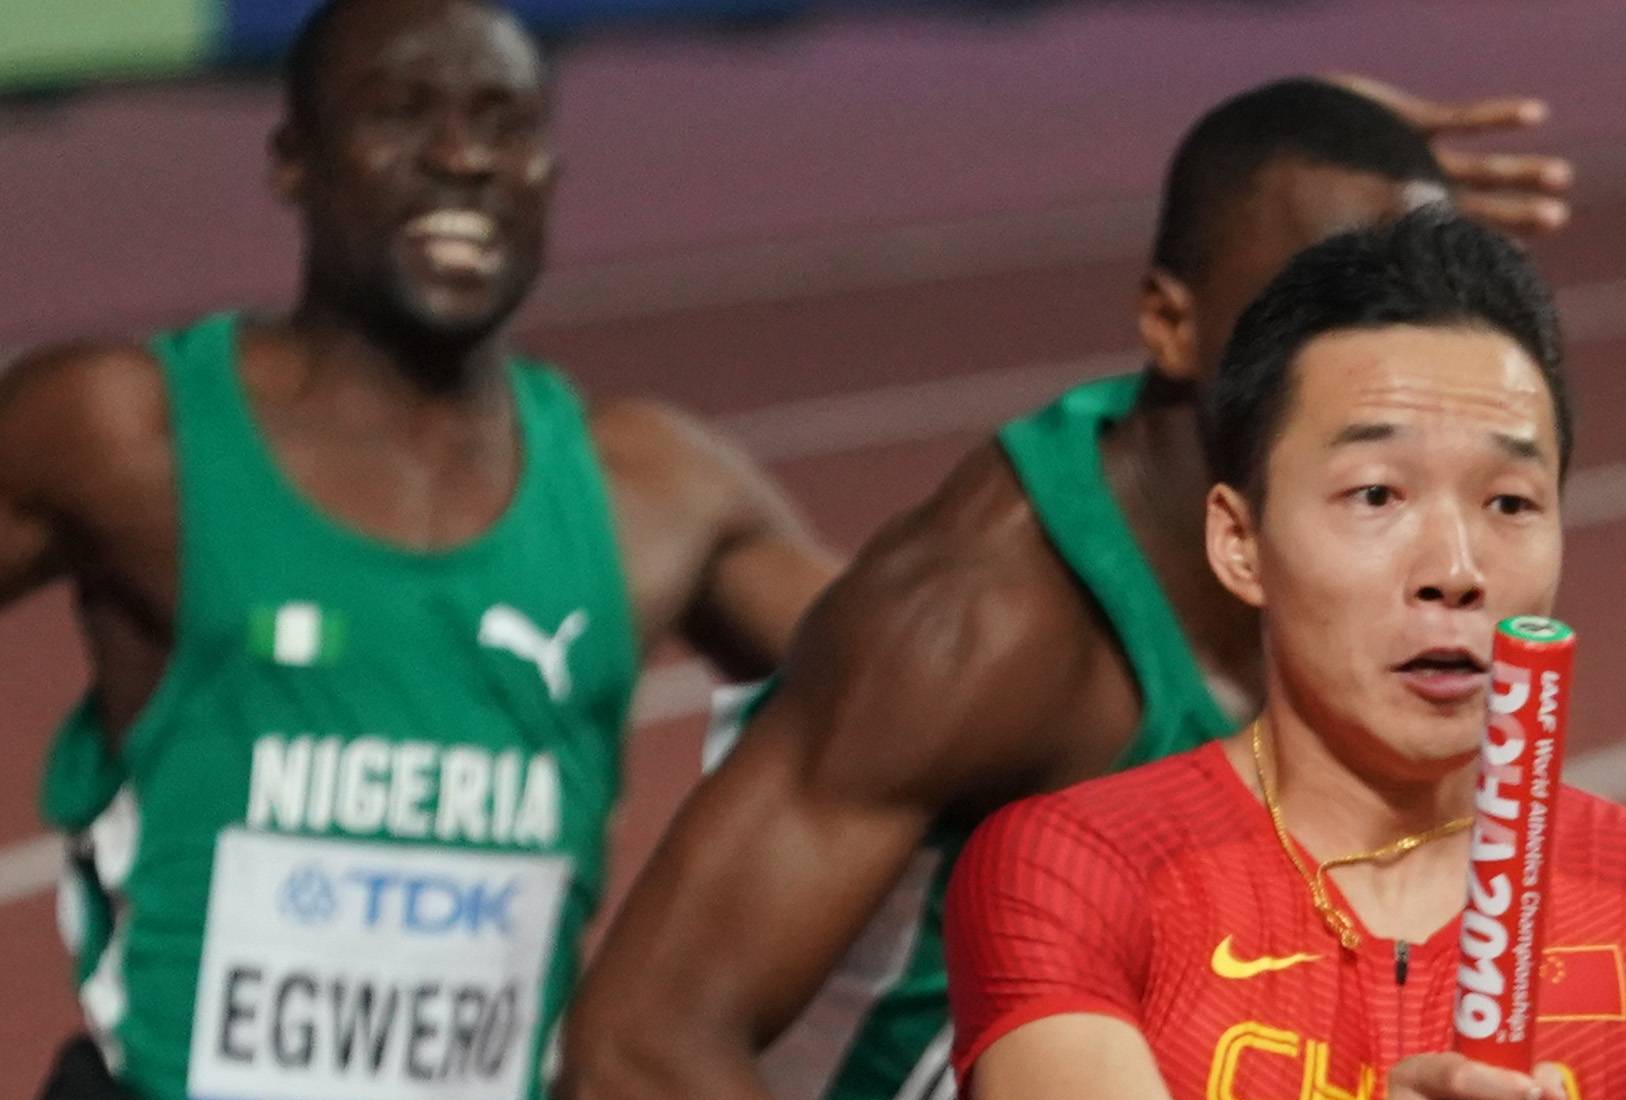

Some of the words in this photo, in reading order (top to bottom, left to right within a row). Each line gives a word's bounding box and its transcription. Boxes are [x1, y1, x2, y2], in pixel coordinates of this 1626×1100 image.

[1538, 671, 1560, 733] IAAF
[249, 735, 559, 844] NIGERIA
[1471, 662, 1531, 862] DOHA
[1532, 739, 1554, 798] World
[1522, 802, 1548, 887] Athletics
[347, 871, 518, 935] TDK
[1455, 873, 1512, 1039] 2019
[1508, 892, 1540, 1042] Championships
[217, 967, 520, 1082] EGWERO
